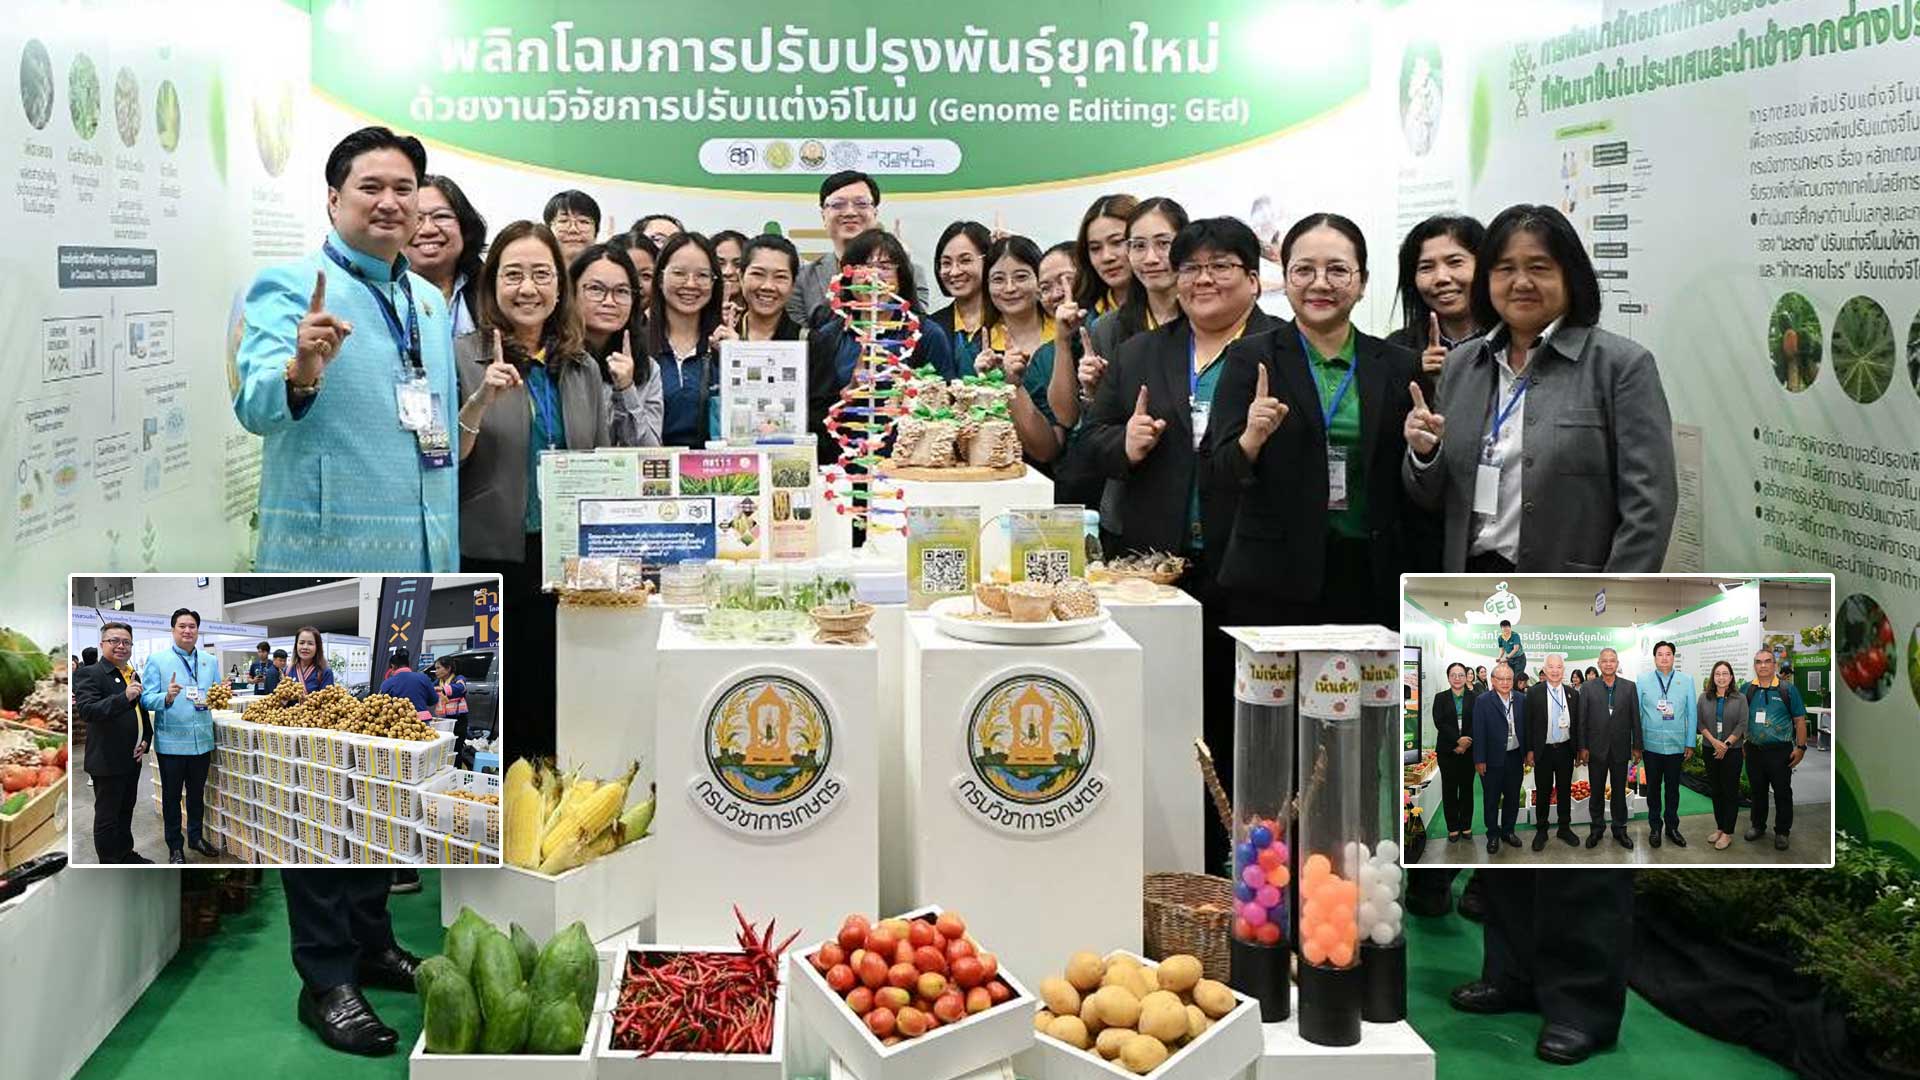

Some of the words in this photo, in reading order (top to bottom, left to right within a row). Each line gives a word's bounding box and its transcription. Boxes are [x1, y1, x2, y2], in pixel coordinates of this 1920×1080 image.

[441, 21, 1220, 88] พลิกโฉมการปรับปรุงพันธุ์ยุคใหม่
[409, 85, 917, 124] ด้วยงานวิจัยการปรับแต่งจีโนม
[930, 97, 1060, 126] (Genome
[1068, 97, 1177, 128] Editing:
[1186, 97, 1250, 126] GEd)
[1854, 257, 1920, 280] ปรับแต่งจีโ
[1485, 595, 1518, 614] GEd
[695, 778, 841, 831] กรมวิชาการเกษตร
[959, 776, 1104, 830] กรมวิชาการเกษตร
